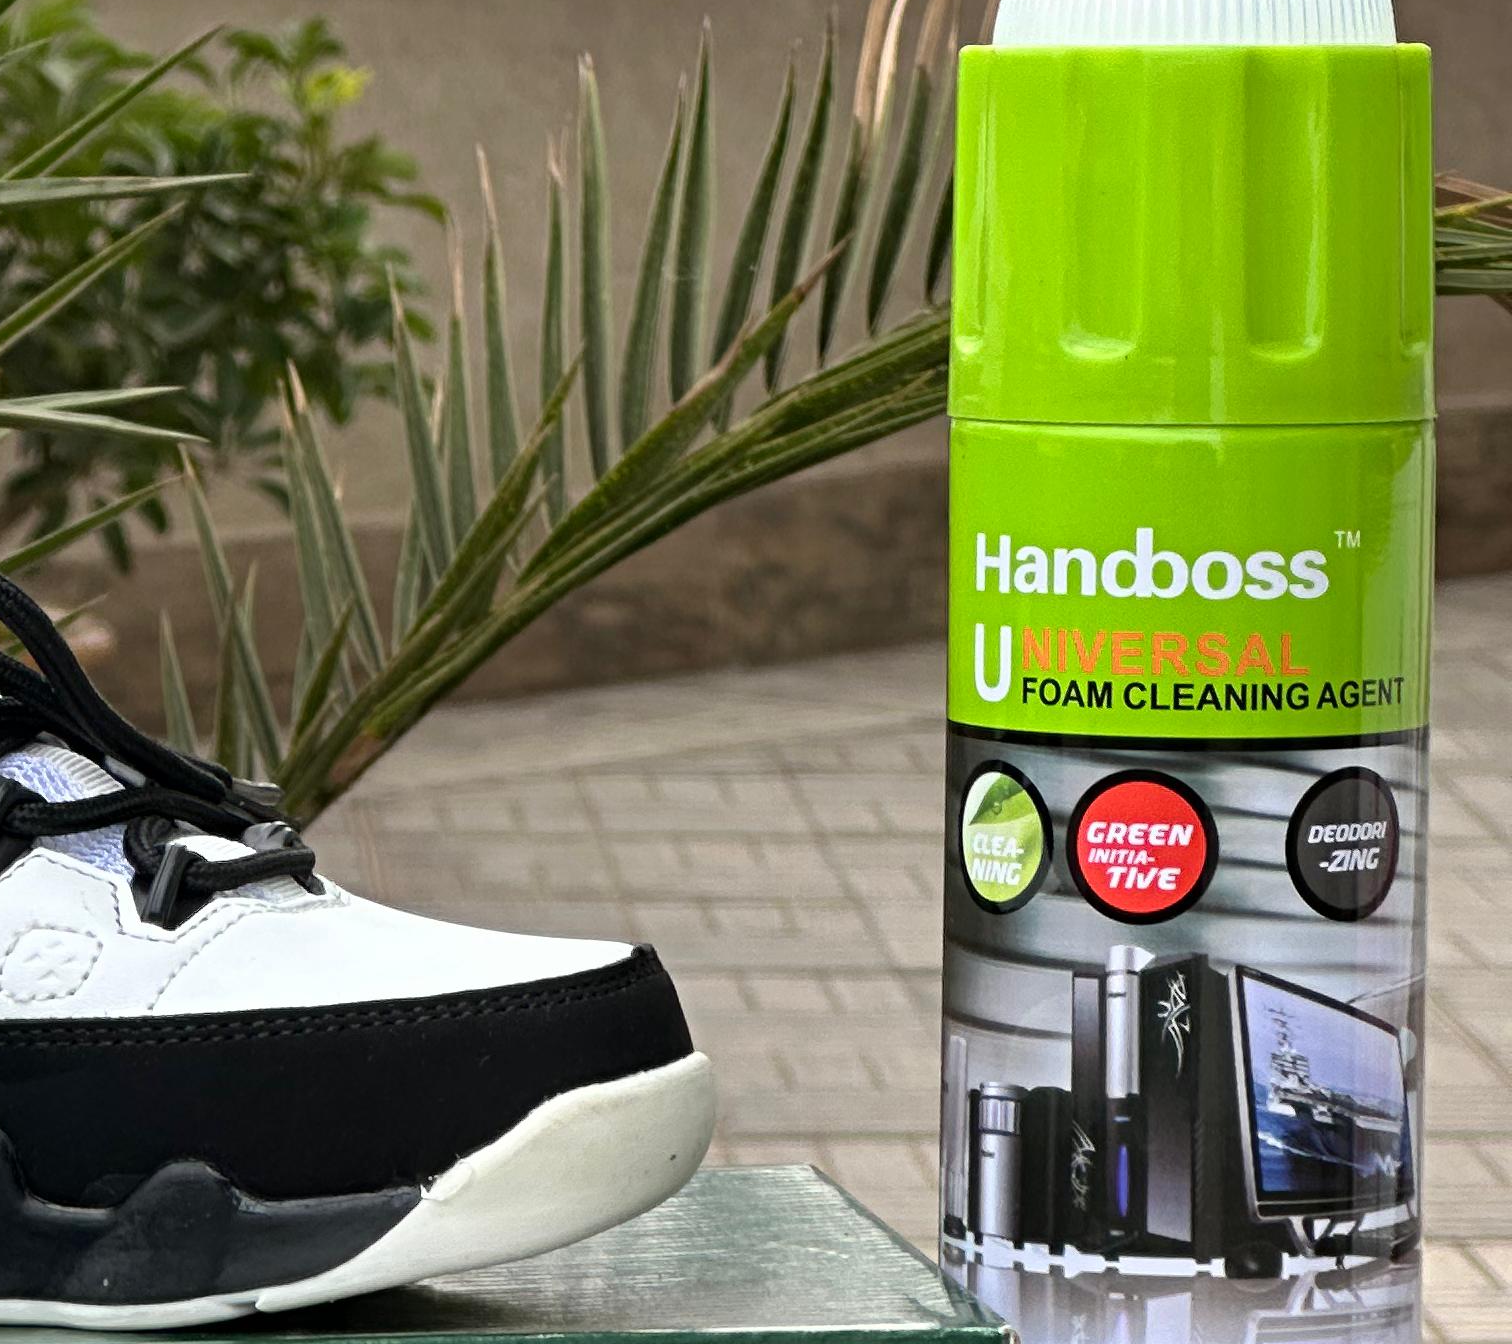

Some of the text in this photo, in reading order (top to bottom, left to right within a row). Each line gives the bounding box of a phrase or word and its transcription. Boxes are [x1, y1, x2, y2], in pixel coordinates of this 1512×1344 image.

[975, 527, 1361, 601] Handboss TM
[1021, 676, 1405, 711] FOAM CLEANING AGENT
[972, 831, 1025, 857] CLEA-
[1086, 821, 1194, 847] GREEN
[1307, 820, 1388, 845] DEODORI
[1088, 847, 1156, 865] INITIA-
[1319, 846, 1381, 873] -ZING
[970, 857, 1023, 886] NING
[1105, 866, 1182, 891] TIVE
